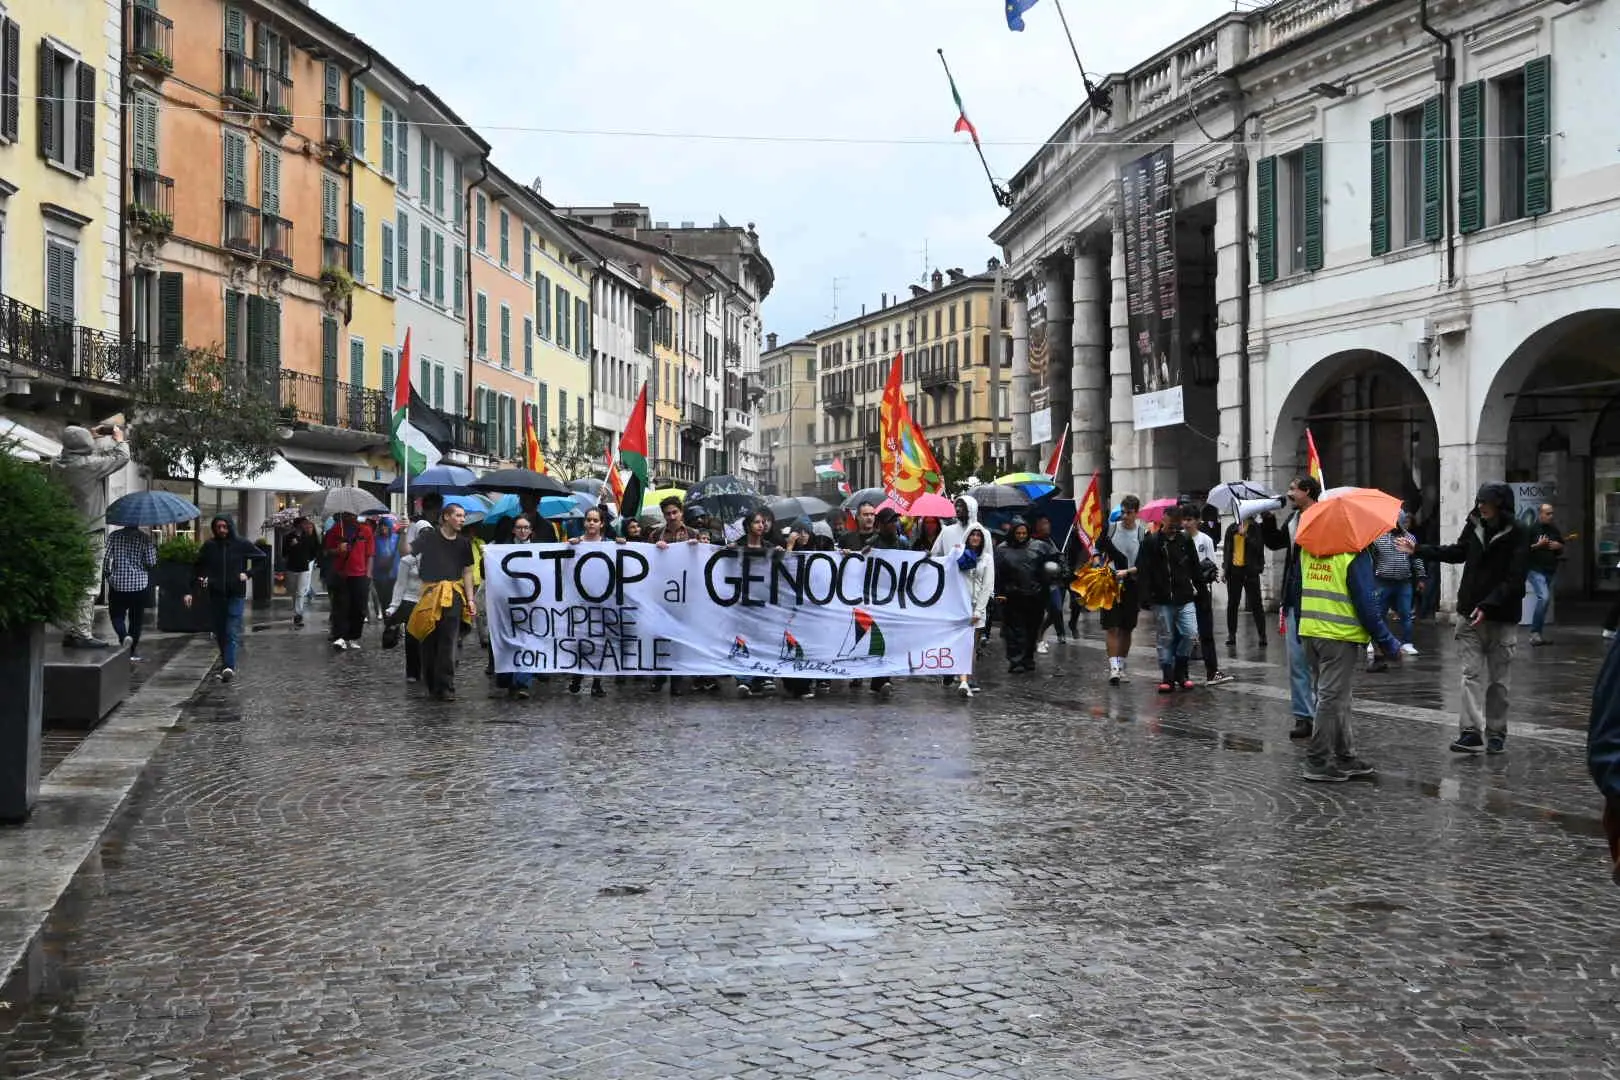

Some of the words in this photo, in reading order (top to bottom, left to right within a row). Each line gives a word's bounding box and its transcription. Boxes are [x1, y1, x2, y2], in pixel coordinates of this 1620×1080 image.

[501, 549, 650, 606] STOP
[663, 569, 688, 604] al
[704, 549, 945, 609] GENOCIDIO
[509, 606, 639, 639] ROMPERE
[513, 650, 547, 669] con
[553, 638, 674, 672] ISRAELE
[907, 647, 955, 674] USB
